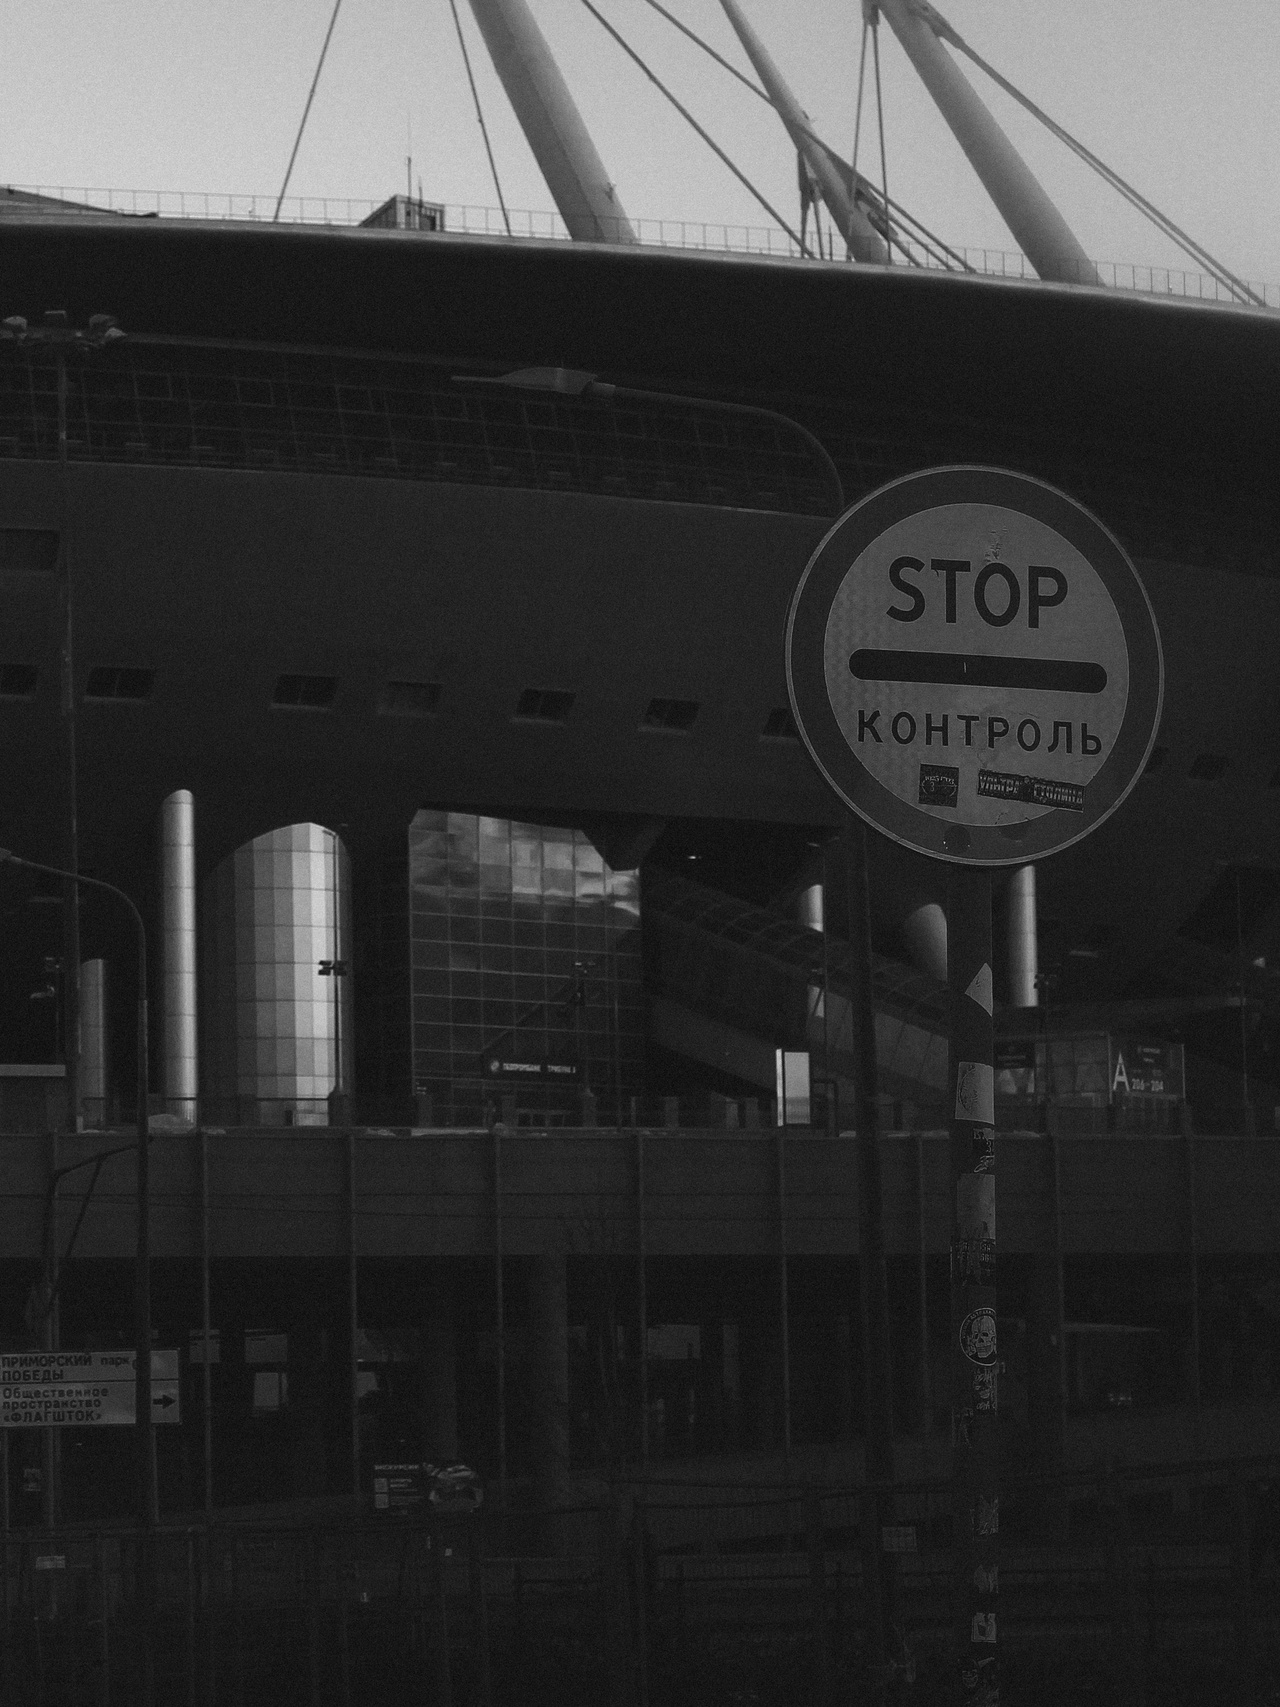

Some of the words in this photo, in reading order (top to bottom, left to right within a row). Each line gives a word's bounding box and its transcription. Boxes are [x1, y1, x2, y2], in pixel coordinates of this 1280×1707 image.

[886, 556, 1068, 629] STOP
[857, 709, 1103, 756] КОНТРОЛЬ
[2, 1353, 92, 1368] ПРИМОРСКИЙ
[100, 1356, 129, 1368] парк
[2, 1369, 64, 1383] ПОБЕДЫ
[2, 1387, 109, 1399] Общественное
[2, 1399, 101, 1411] пространство
[3, 1410, 101, 1423] «ФЛАГШТОК»
